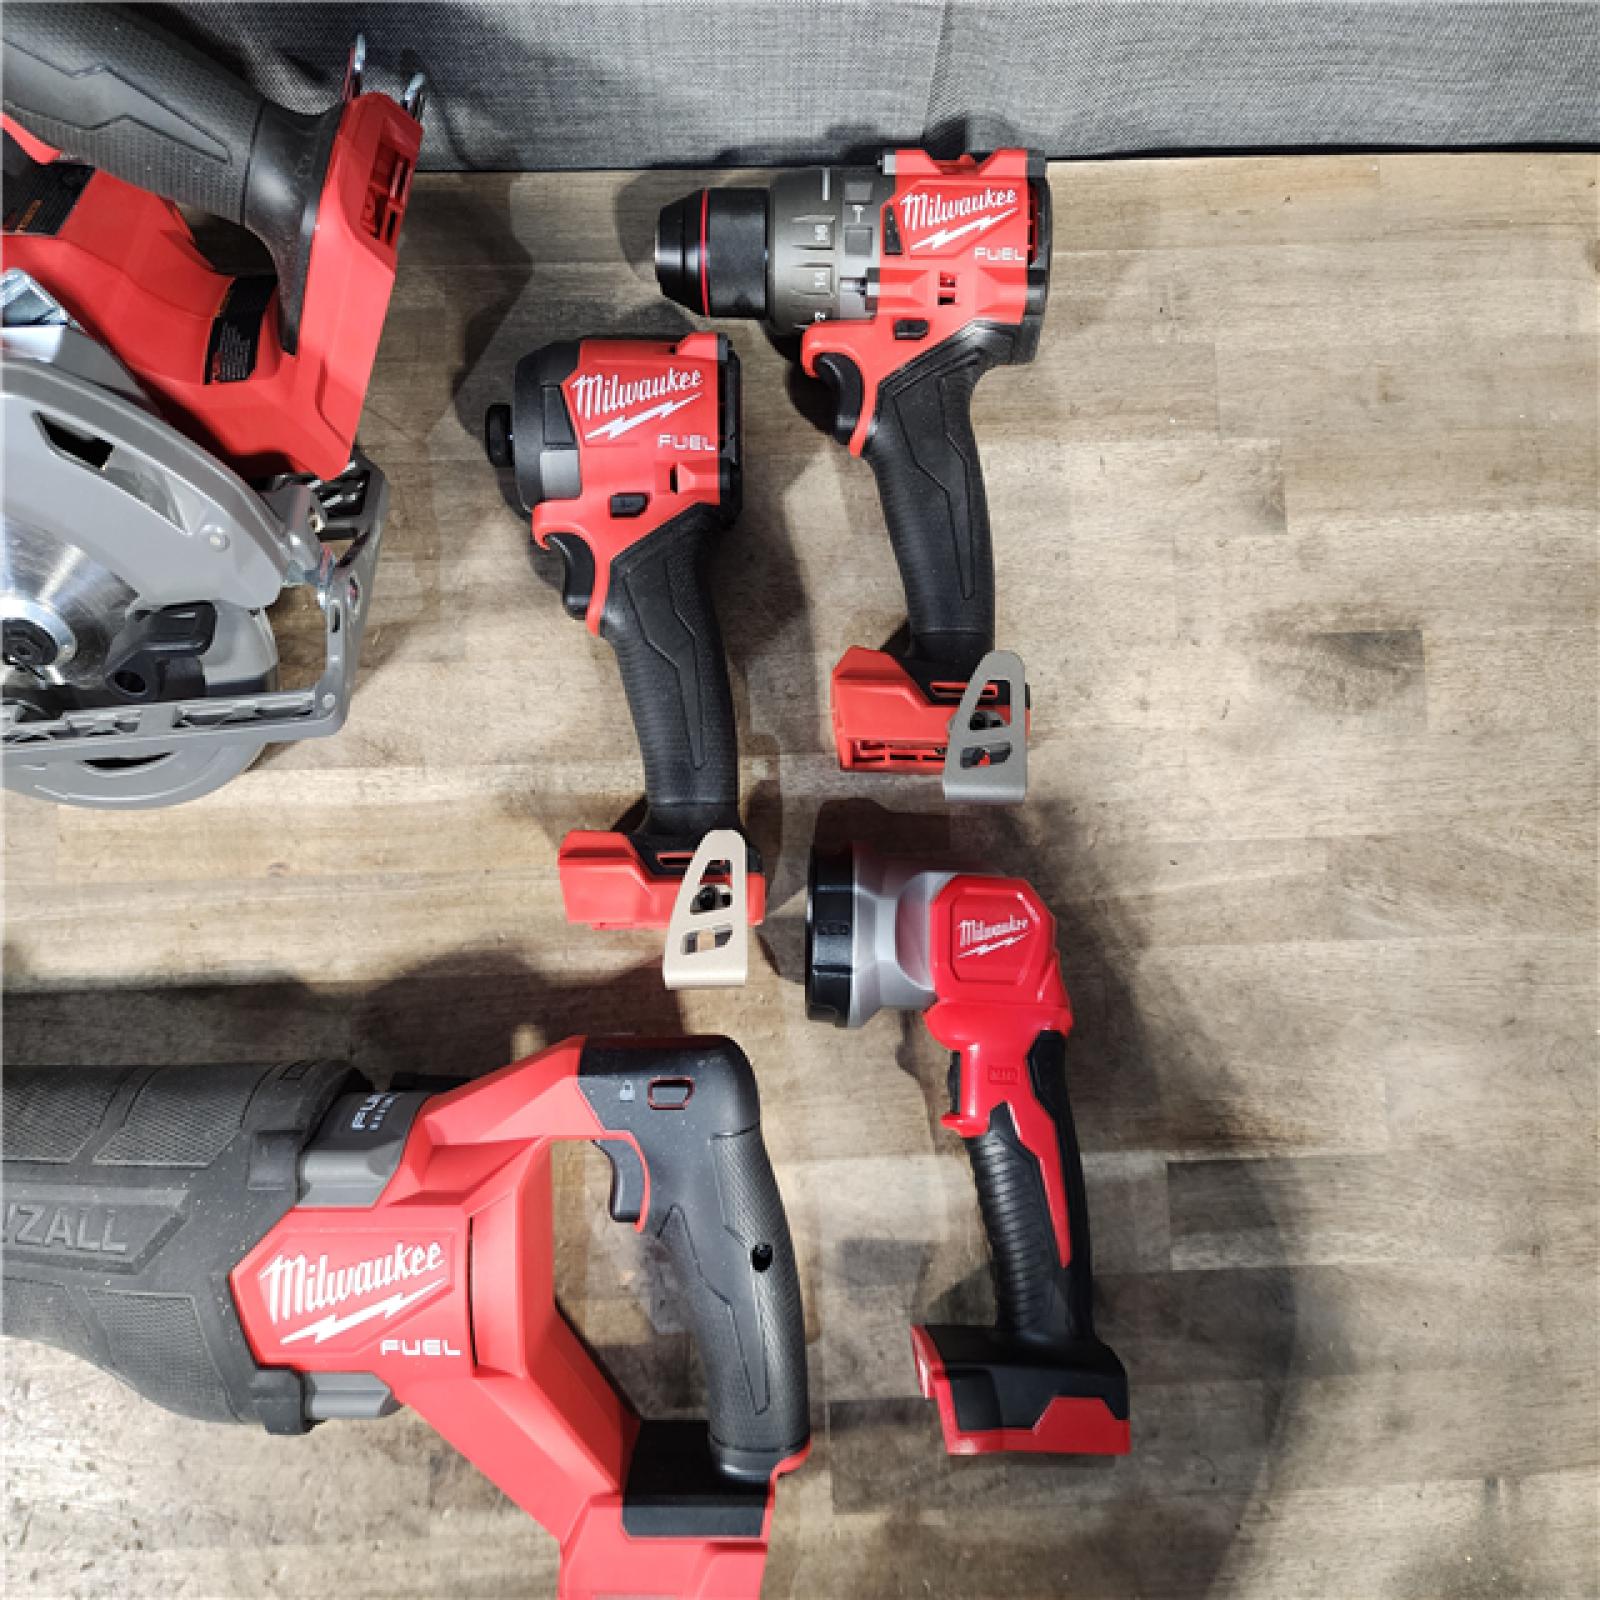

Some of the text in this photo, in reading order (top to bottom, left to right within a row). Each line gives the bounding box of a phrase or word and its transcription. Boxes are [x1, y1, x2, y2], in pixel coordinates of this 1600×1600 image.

[899, 187, 1017, 232] Milwaukee
[974, 247, 1026, 261] FUEL
[570, 367, 702, 420] Milwaukee
[657, 434, 716, 451] FUEL
[3, 1202, 128, 1253] ZALL
[258, 1241, 446, 1326] Milwaukee
[380, 1339, 461, 1356] FUEL
